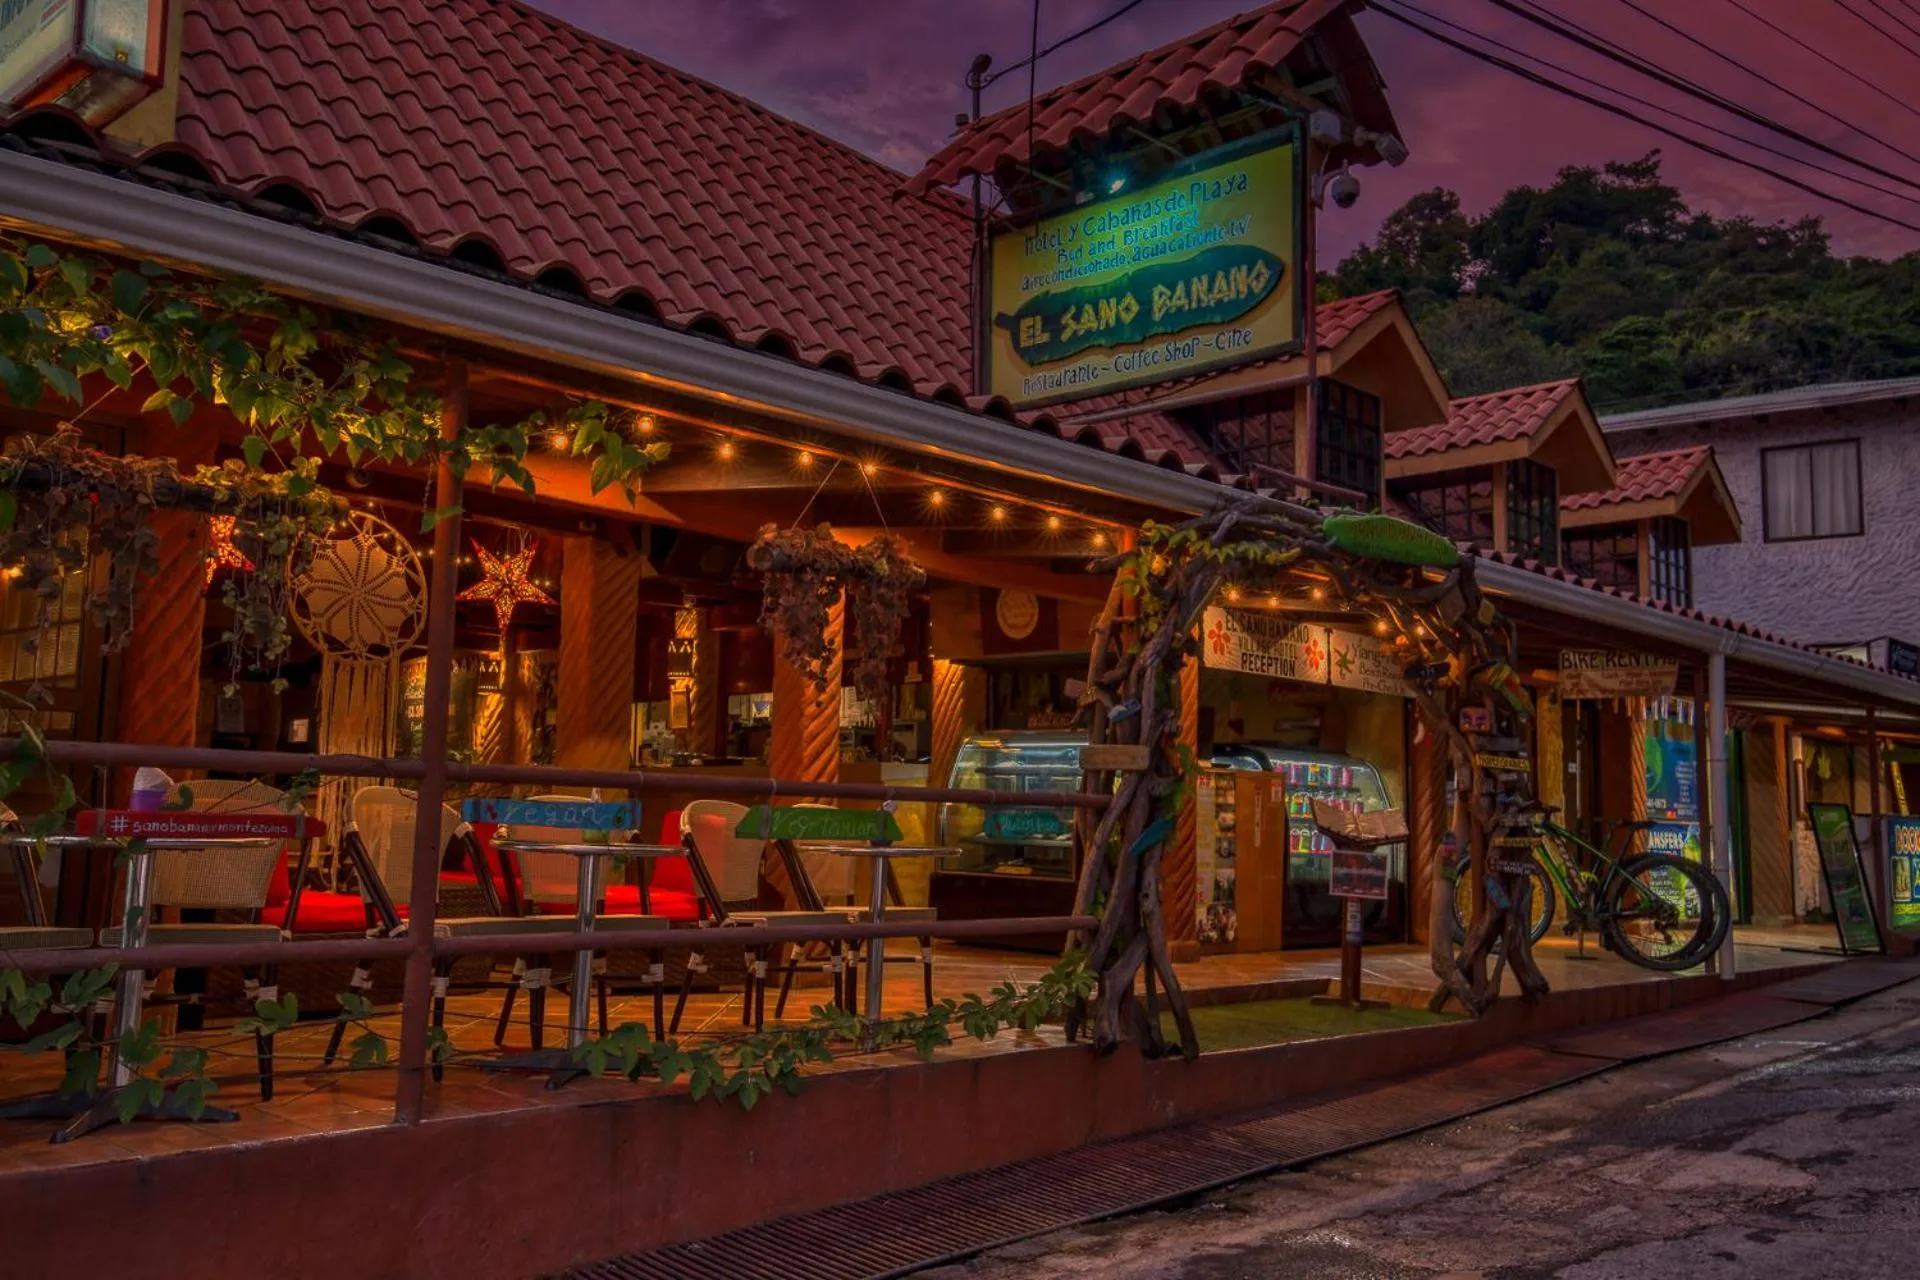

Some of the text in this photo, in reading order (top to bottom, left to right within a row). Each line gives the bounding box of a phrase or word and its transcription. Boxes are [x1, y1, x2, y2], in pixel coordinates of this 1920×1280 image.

[1058, 209, 1199, 264] Bed and Breakfast
[1068, 223, 1079, 243] y
[1165, 191, 1185, 212] de
[1019, 258, 1272, 349] EL SANO BANANO
[1114, 349, 1160, 373] Coffee
[1241, 652, 1296, 678] RECEPTION
[1561, 651, 1599, 669] BIKE
